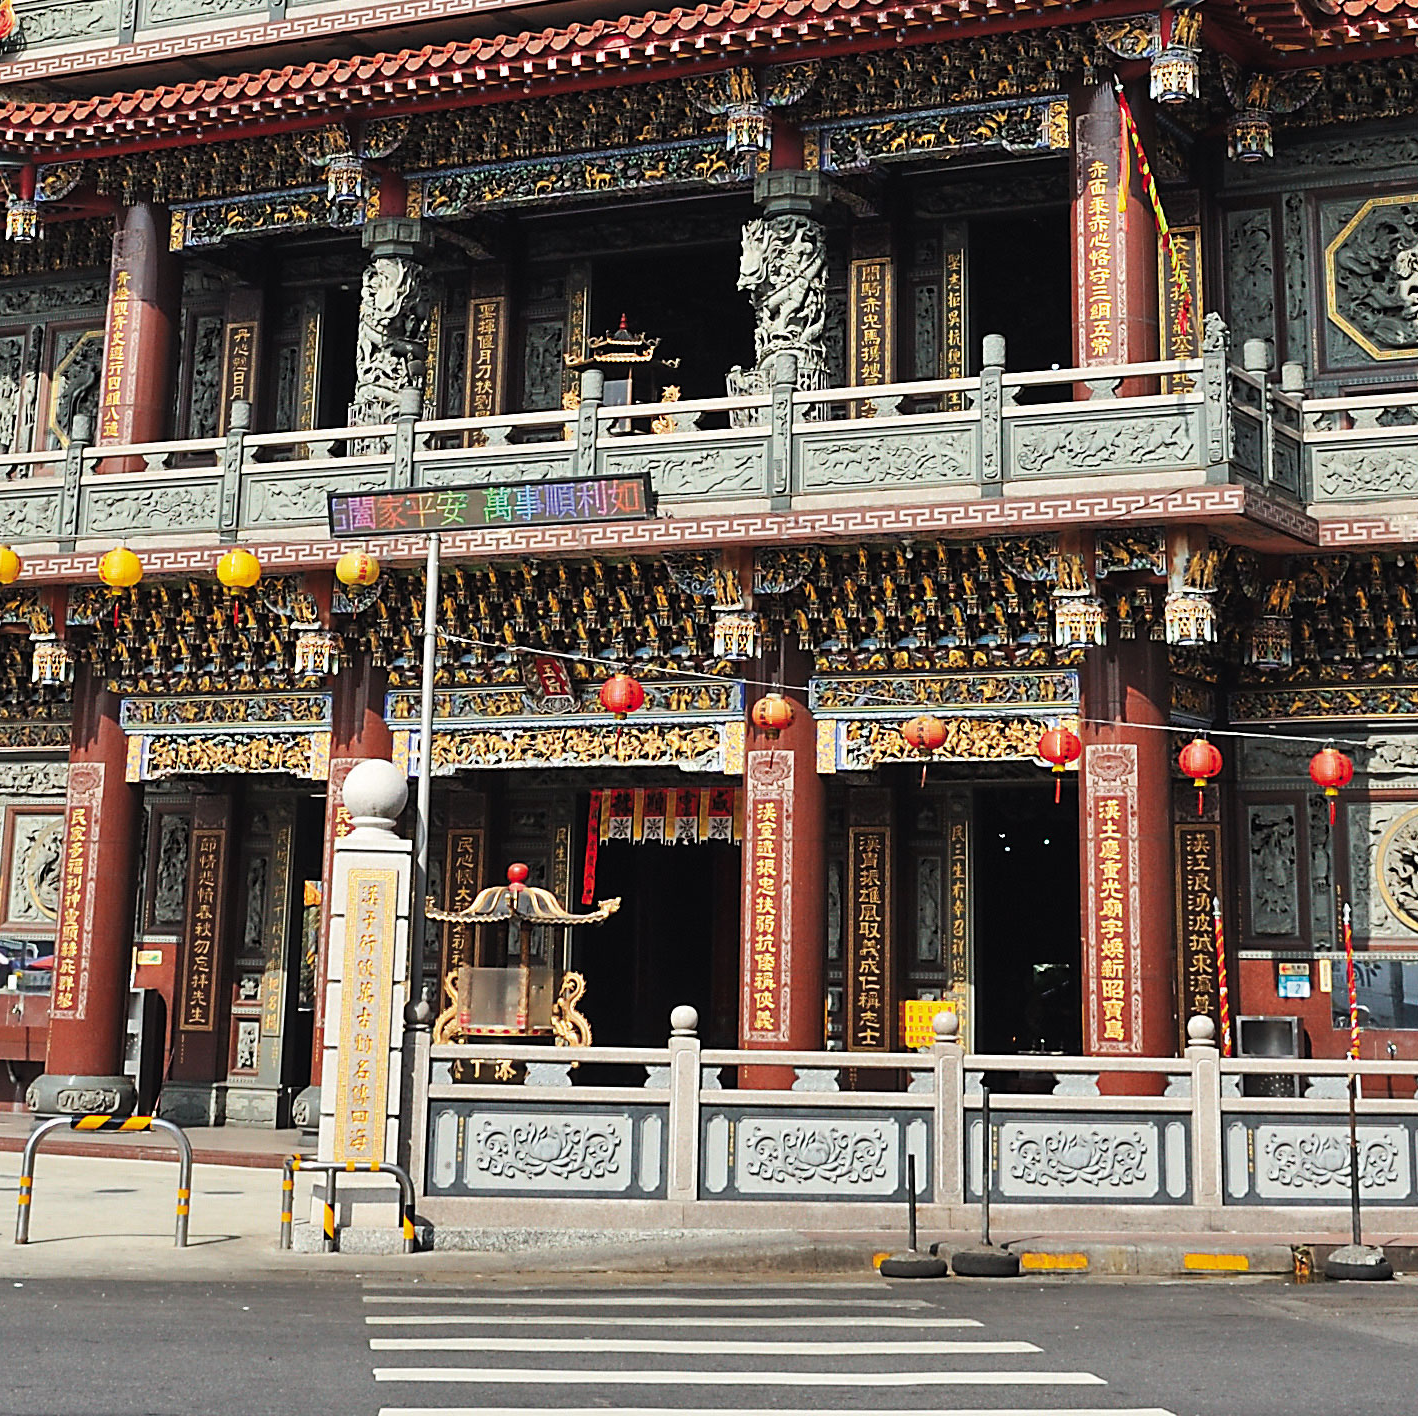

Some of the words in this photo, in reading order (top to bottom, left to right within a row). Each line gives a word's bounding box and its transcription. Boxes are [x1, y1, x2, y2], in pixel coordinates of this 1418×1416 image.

[481, 479, 641, 523] 萬事順利如
